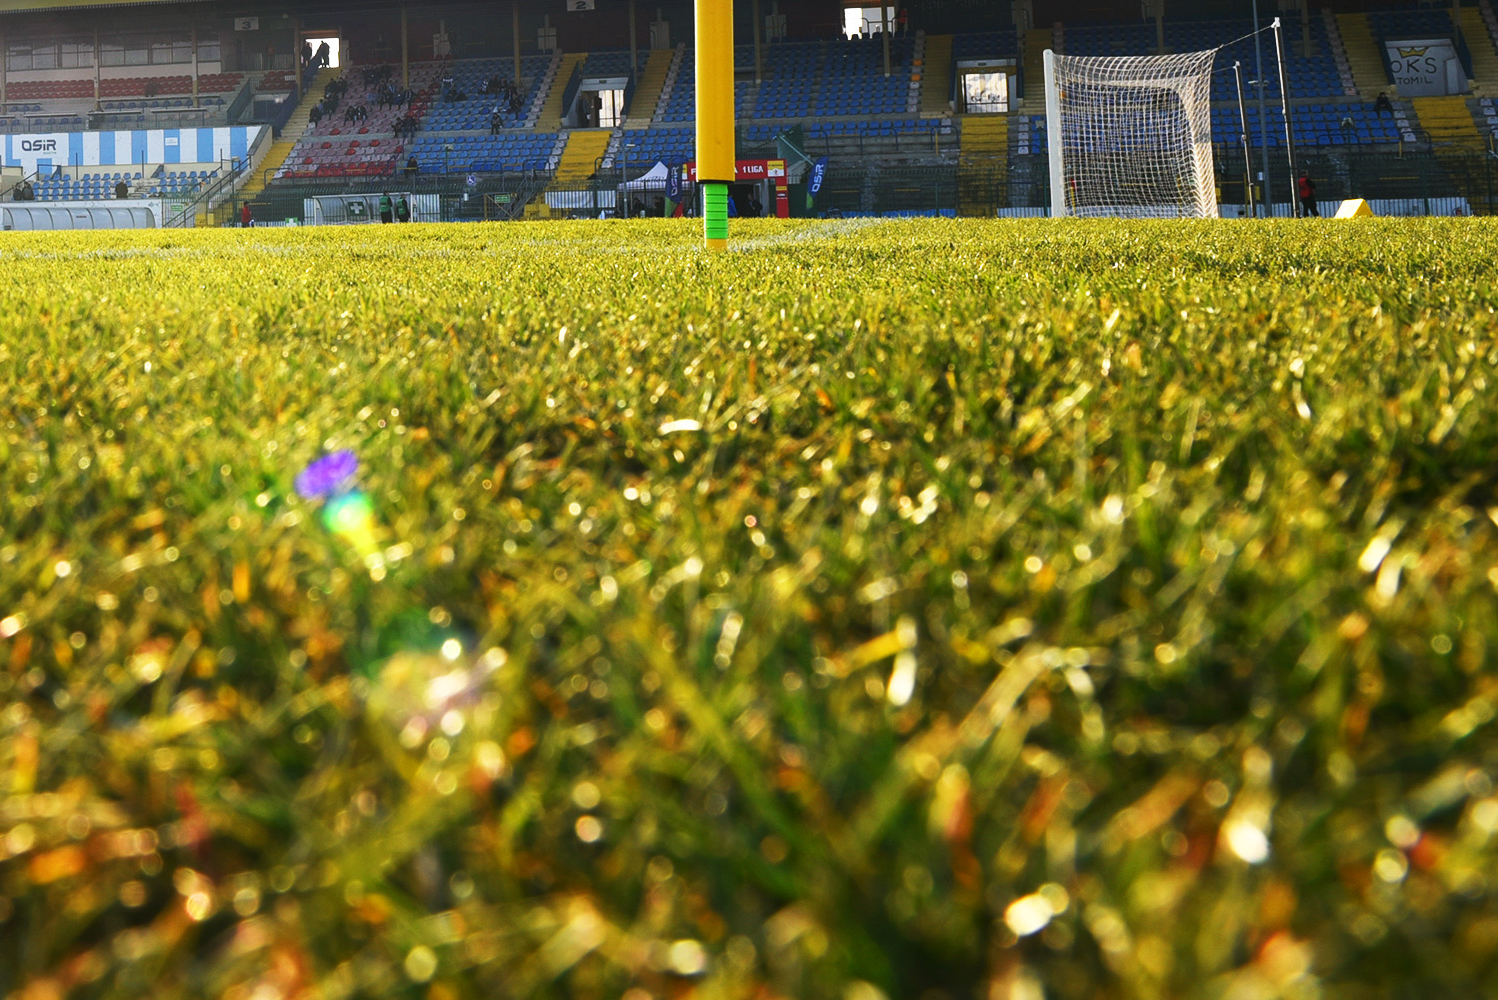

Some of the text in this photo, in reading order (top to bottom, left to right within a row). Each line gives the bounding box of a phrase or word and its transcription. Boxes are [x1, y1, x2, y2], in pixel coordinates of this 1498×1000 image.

[575, 1, 586, 10] 2
[242, 21, 251, 30] 3
[1390, 57, 1437, 74] OKS
[1396, 76, 1433, 85] TOMIL
[747, 165, 764, 174] LIGA
